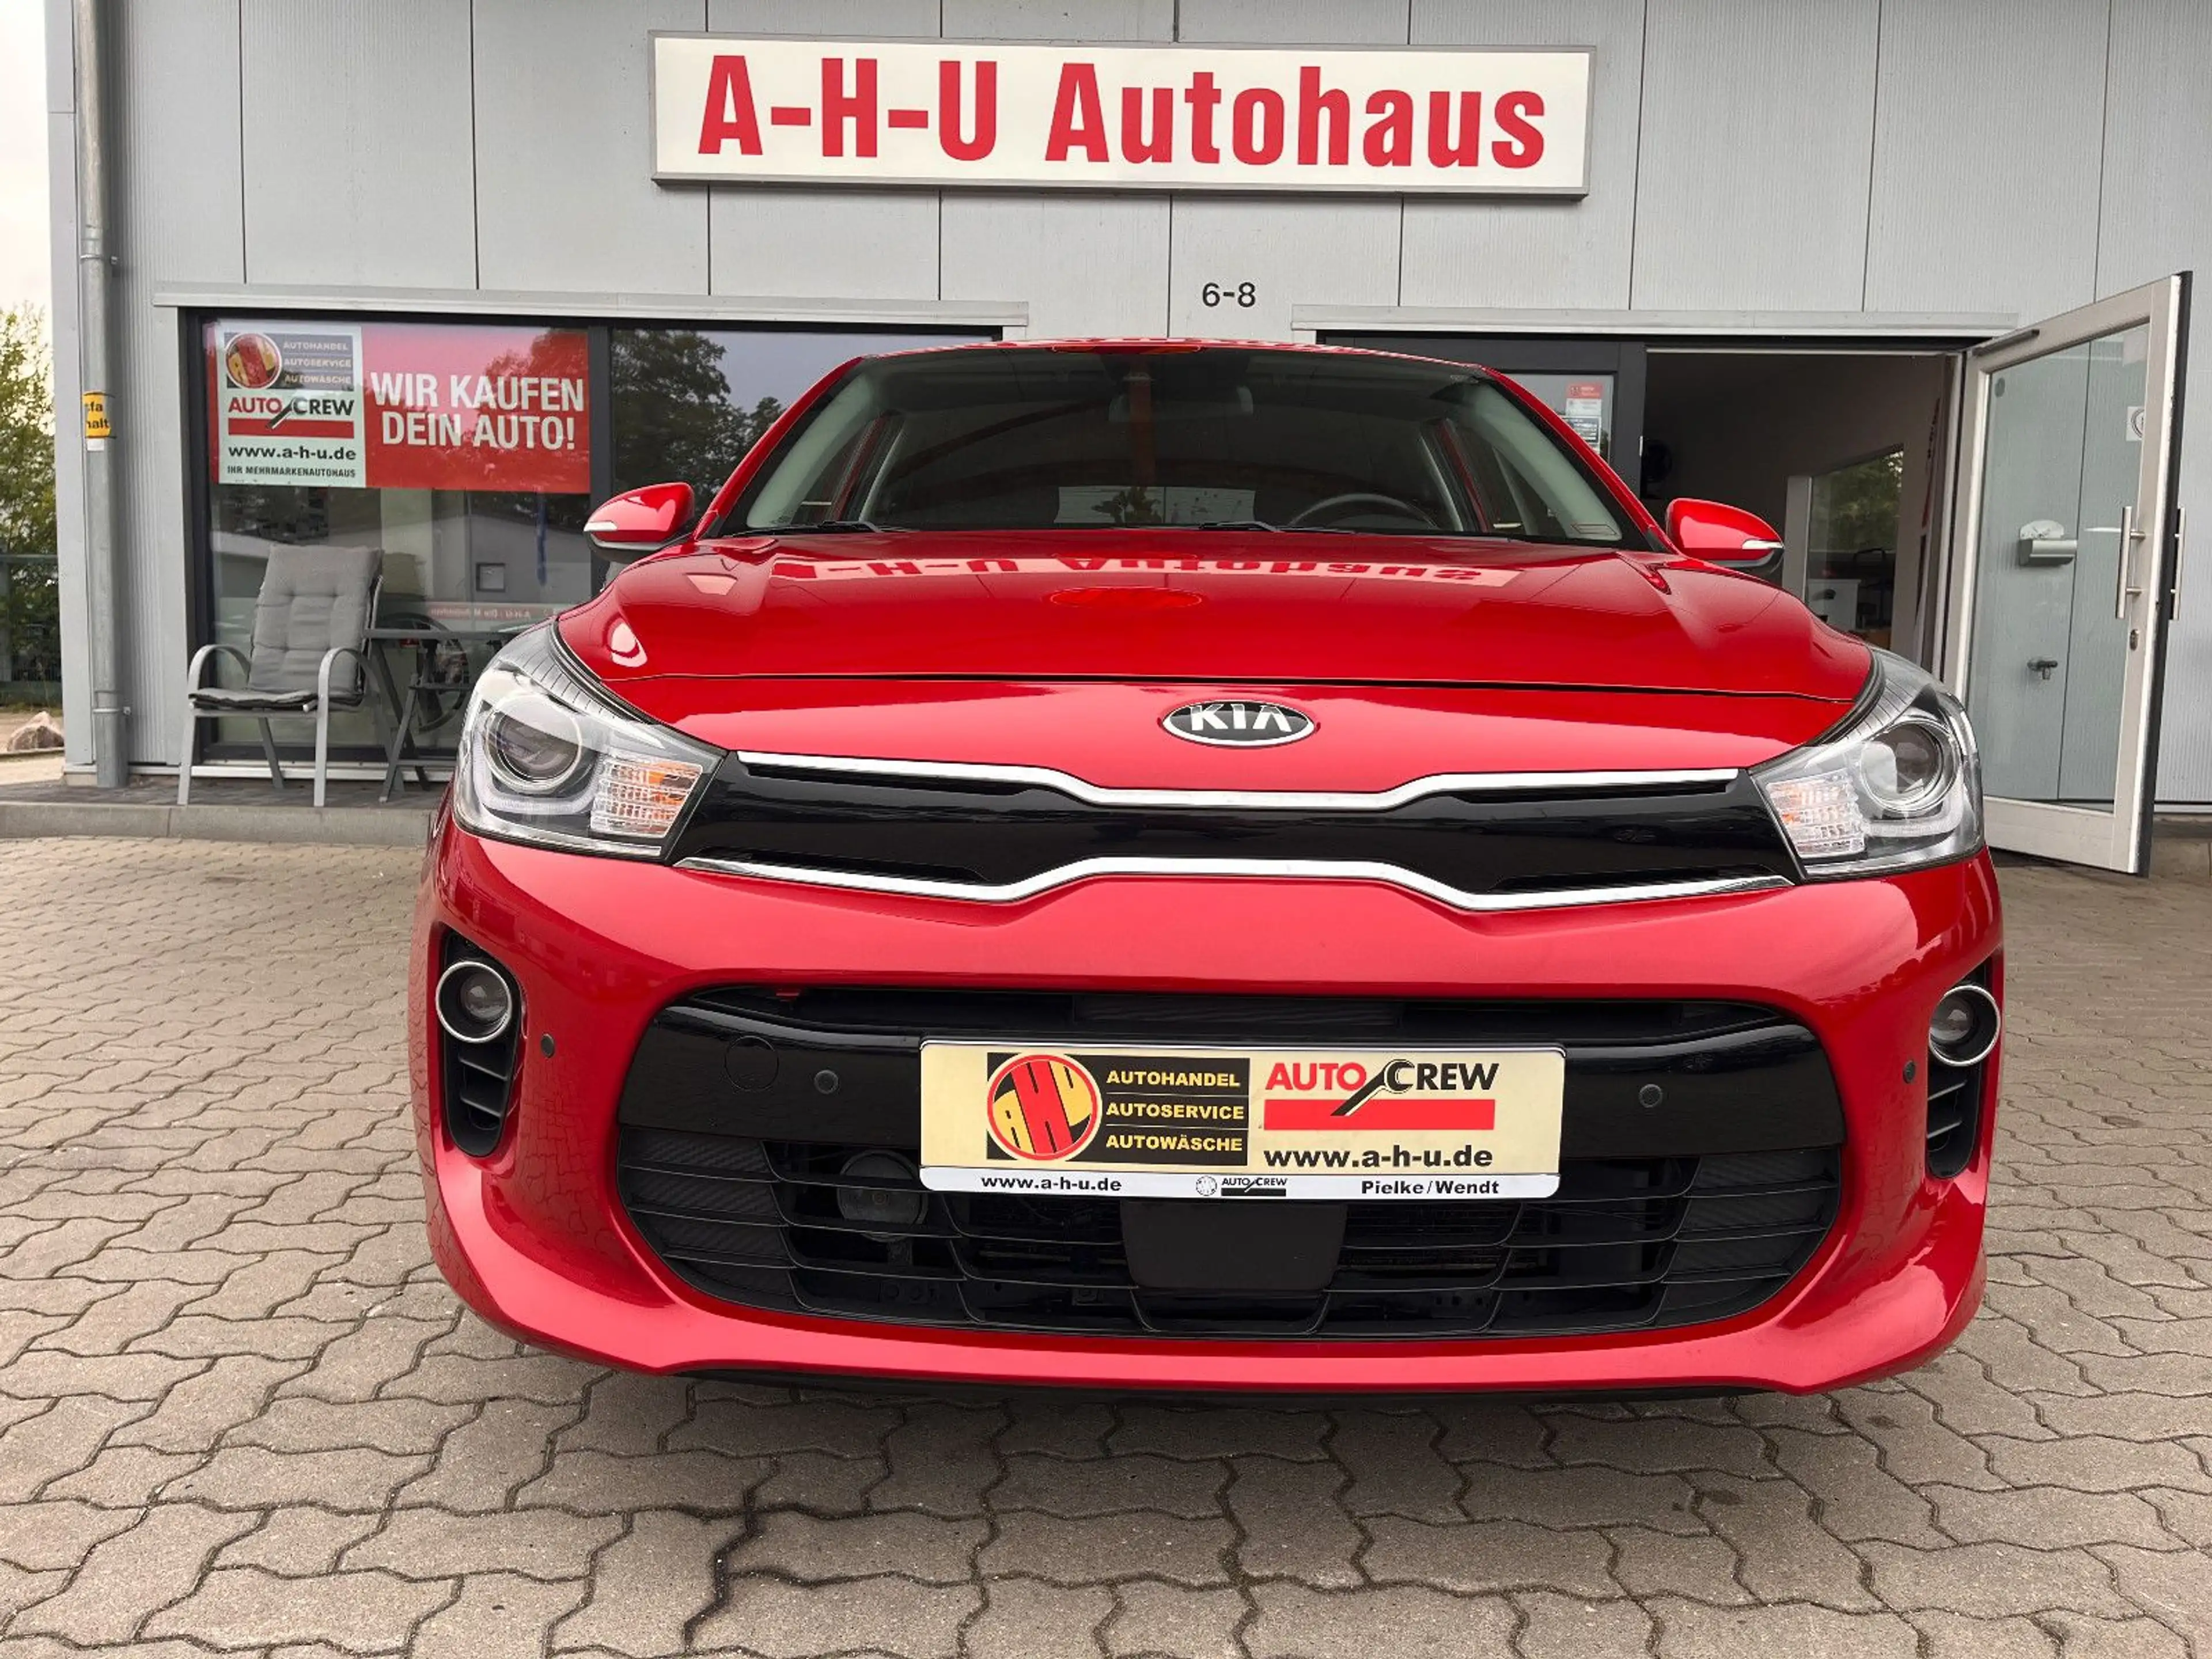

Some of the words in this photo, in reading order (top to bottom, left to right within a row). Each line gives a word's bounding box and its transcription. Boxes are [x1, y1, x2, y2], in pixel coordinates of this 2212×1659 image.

[698, 55, 998, 162] A-H-U
[1044, 62, 1546, 169] Autohaus
[1202, 282, 1256, 308] 6-8
[283, 342, 349, 351] AUTOHANDEL
[284, 358, 352, 368] AUTOSERVICE
[370, 372, 438, 407] WIR
[450, 374, 585, 411] KAUFEN
[382, 411, 461, 446] DEIN
[472, 414, 575, 450] AUTO!
[228, 445, 357, 460] www.a-h-u.de
[228, 465, 243, 474] IHR
[245, 465, 356, 478] MEHRMARKENAUTOHAUS
[1189, 703, 1293, 732] KIA
[1106, 1069, 1241, 1088] AUTOHANDEL
[1267, 1062, 1367, 1091] AUTO
[1384, 1058, 1499, 1094] CREW
[1106, 1101, 1245, 1120] AUTOSERVICE
[1106, 1132, 1243, 1152] AUTOWÄSCHE
[1263, 1144, 1493, 1168] www.a-h-u.de
[981, 1176, 1122, 1192] www.a-h-u.de
[1361, 1180, 1499, 1195] Pielke/Wendt
